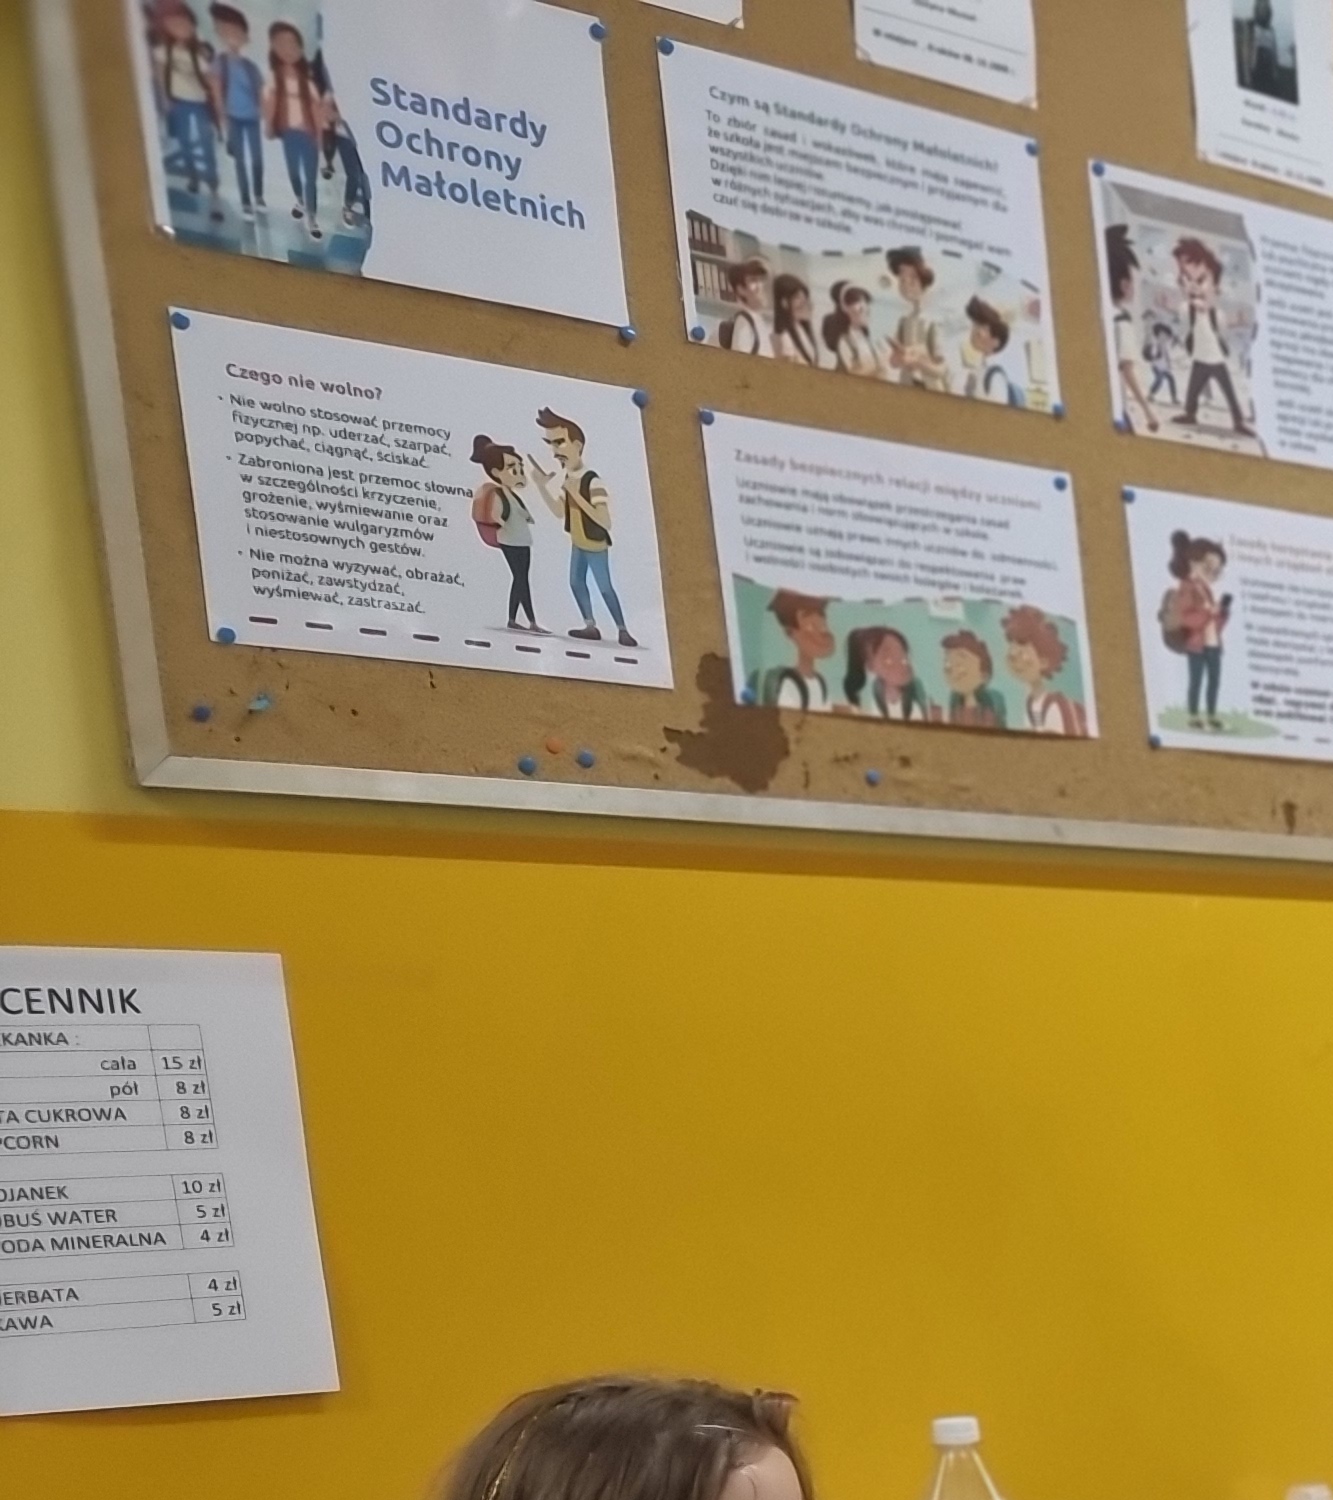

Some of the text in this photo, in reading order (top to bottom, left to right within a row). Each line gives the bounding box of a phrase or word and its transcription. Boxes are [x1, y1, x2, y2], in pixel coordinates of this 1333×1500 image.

[708, 85, 750, 106] Czym
[370, 77, 547, 148] Standardy
[375, 120, 522, 181] Ochrony
[381, 161, 585, 230] Małoletnich
[225, 363, 383, 401] Czego nie wolno?
[229, 393, 451, 441] Nie wolno stosować przemocy
[232, 409, 298, 435] fizycznej
[329, 427, 391, 448] uderzać,
[394, 438, 452, 457] szarpać,
[234, 431, 311, 453] popychać,
[238, 453, 474, 498] Zabroniona jest przemoc słowna
[240, 473, 441, 511] w szczególności krzyczenie,
[242, 489, 448, 527] grożenie, wyśmiewanie oraz
[244, 507, 434, 542] stosowanie wulgaryzmów
[254, 525, 365, 550] niestosownych
[369, 541, 425, 557] gestów.
[249, 547, 275, 562] Nie
[279, 553, 329, 569] można
[0, 987, 142, 1015] CENNIK
[0, 1032, 69, 1047] KANKA
[100, 1055, 202, 1071] cała 15 zł
[109, 1080, 206, 1099] pół 8 zł
[24, 1107, 128, 1124] CUKROWA
[179, 1105, 191, 1120] 8
[196, 1105, 210, 1120] zł
[0, 1130, 214, 1150] CORN 8 zł
[181, 1180, 203, 1194] 10
[208, 1178, 221, 1193] zł
[0, 1203, 226, 1228] BUŚ WATER 5 zł
[0, 1227, 230, 1254] ODA MINERALNA 4 zł
[0, 1276, 238, 1306] ERBATA 4 zł
[211, 1302, 223, 1317] 5
[228, 1301, 241, 1316] zł
